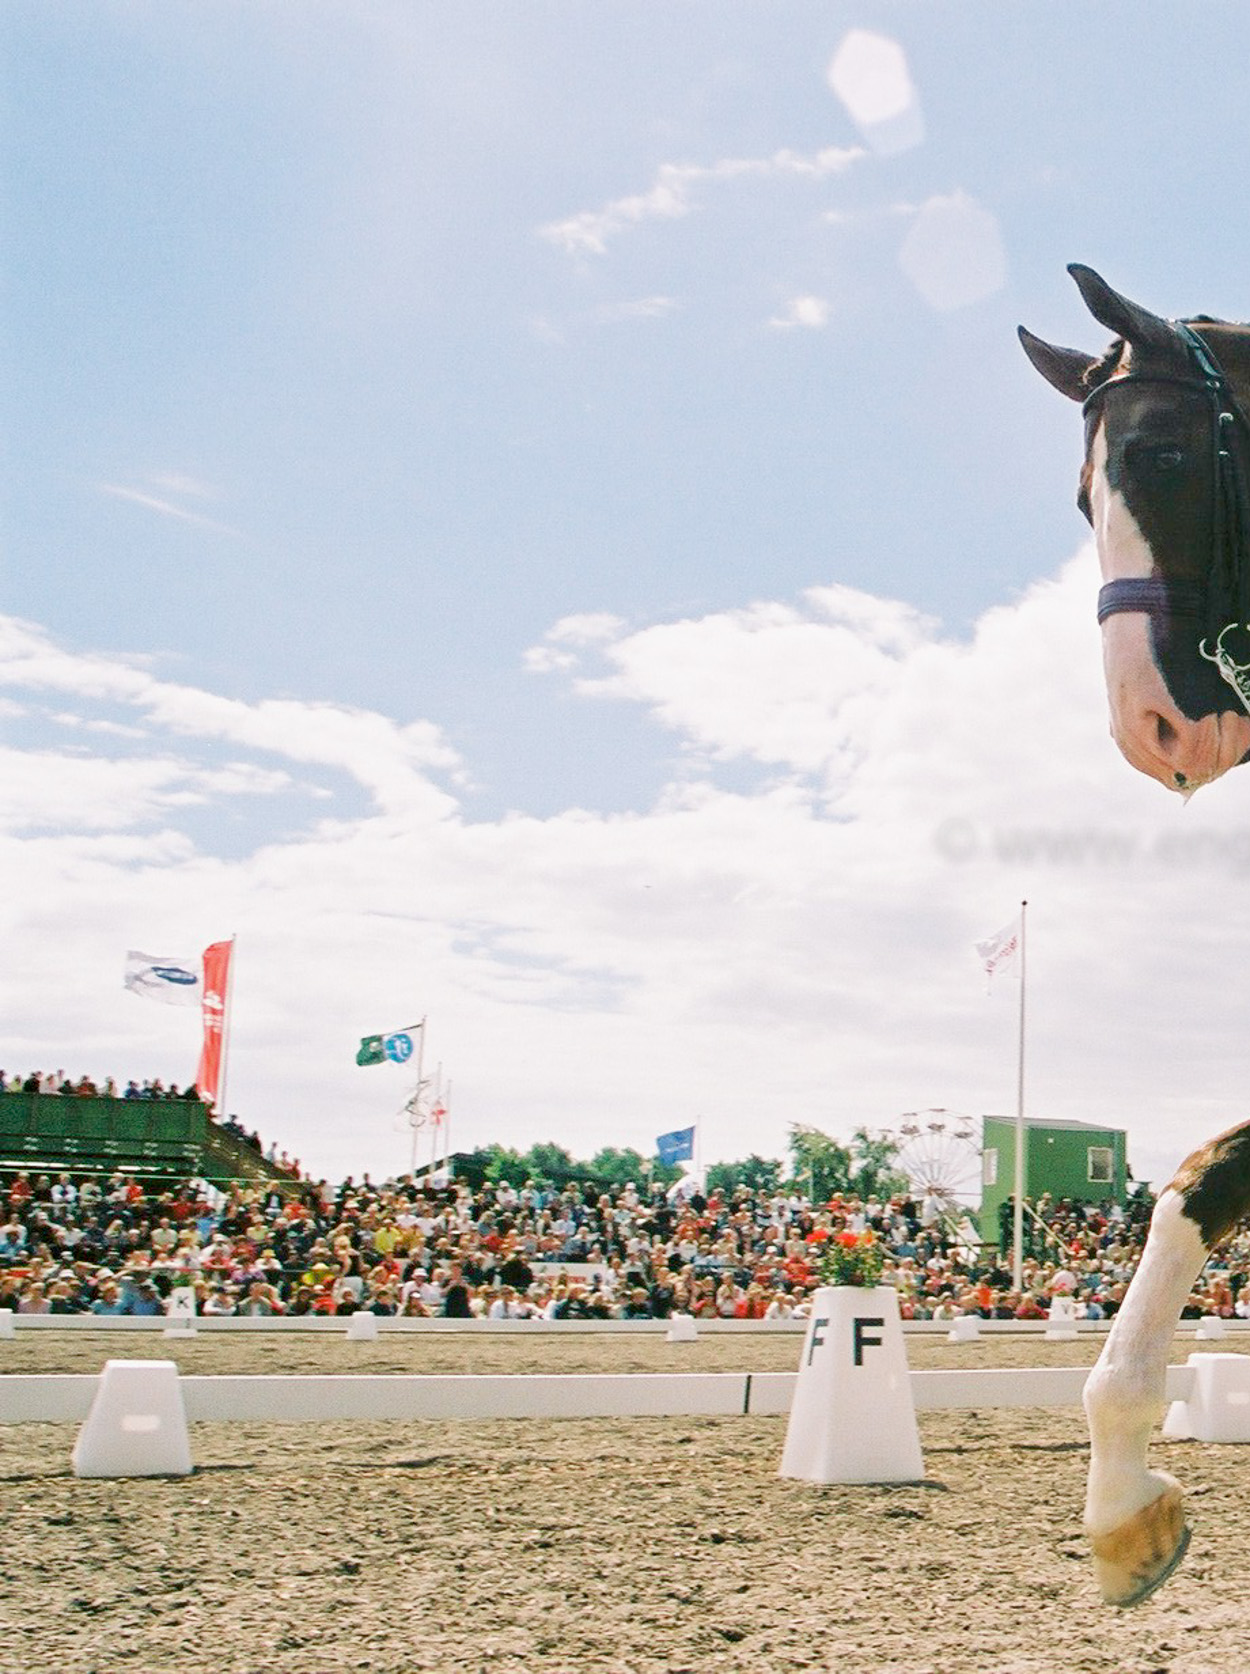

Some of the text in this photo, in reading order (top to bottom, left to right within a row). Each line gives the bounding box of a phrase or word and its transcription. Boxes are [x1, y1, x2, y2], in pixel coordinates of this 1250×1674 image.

[176, 1296, 189, 1309] K
[808, 1318, 829, 1366] F
[853, 1318, 884, 1366] F
